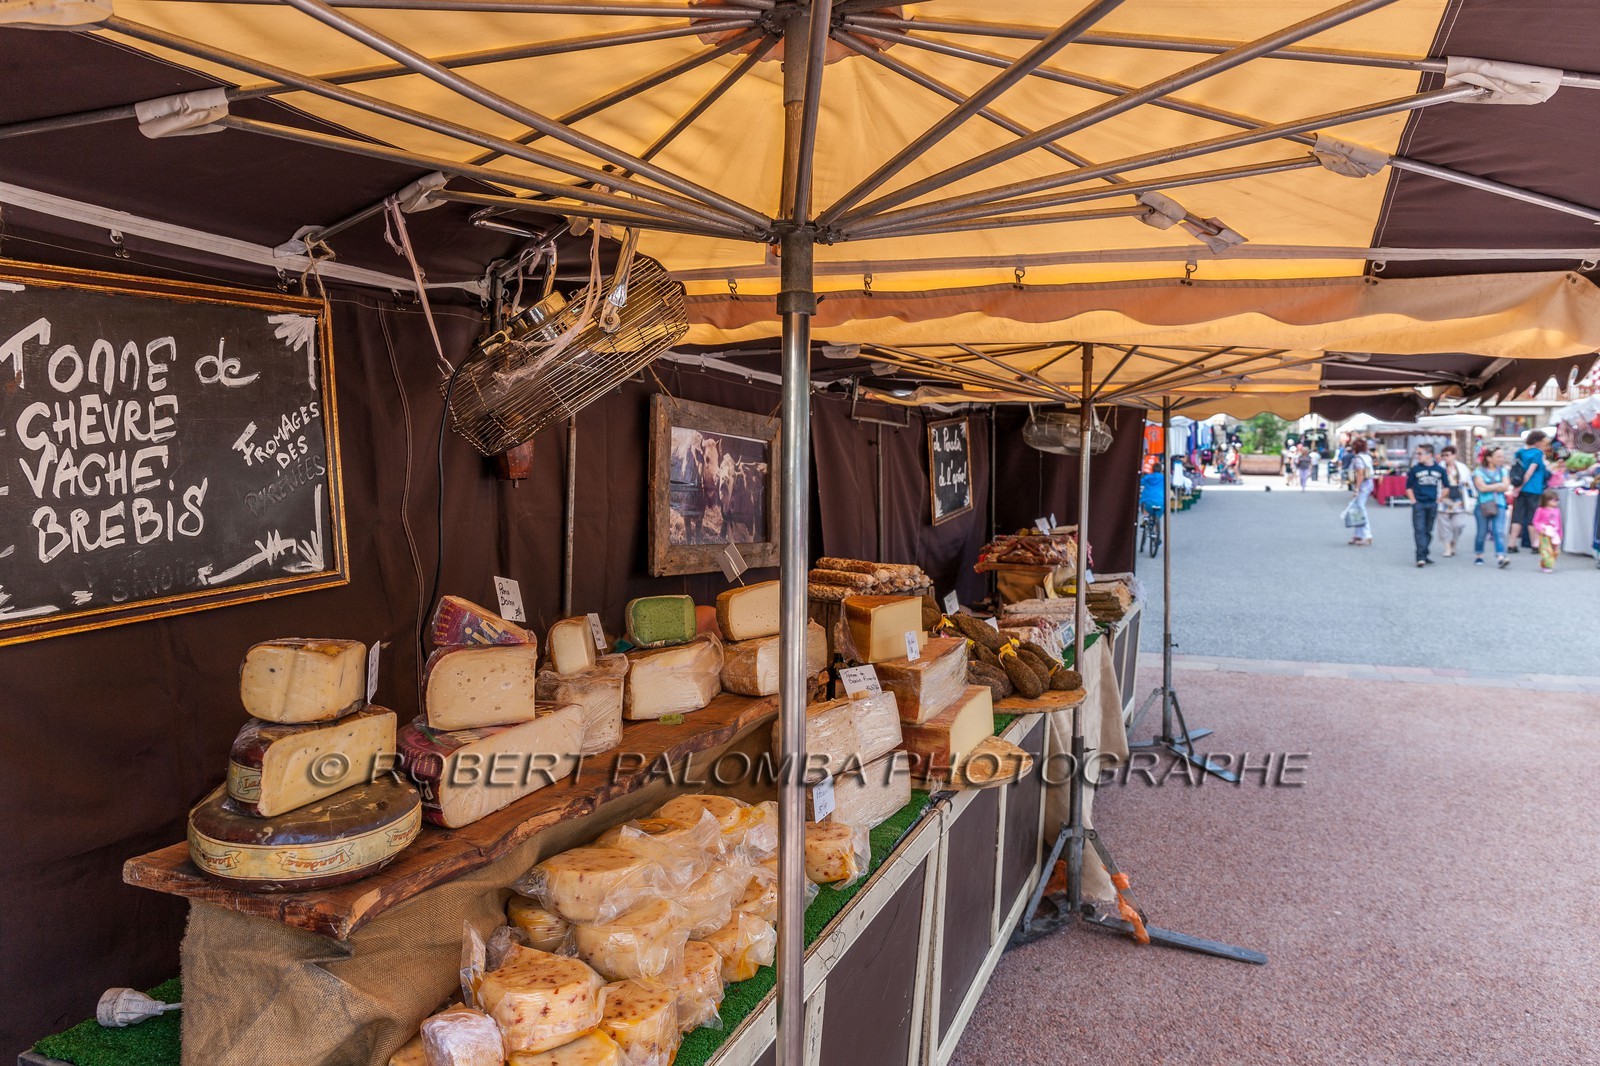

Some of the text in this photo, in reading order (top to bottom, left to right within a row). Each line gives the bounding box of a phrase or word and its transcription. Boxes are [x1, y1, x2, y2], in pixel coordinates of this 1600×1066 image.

[194, 336, 260, 388] de
[16, 394, 178, 453] CHEVRE
[232, 402, 320, 467] FROMAGES
[276, 435, 309, 469] DES
[32, 477, 209, 564] BREBIS
[286, 852, 345, 871] Landana
